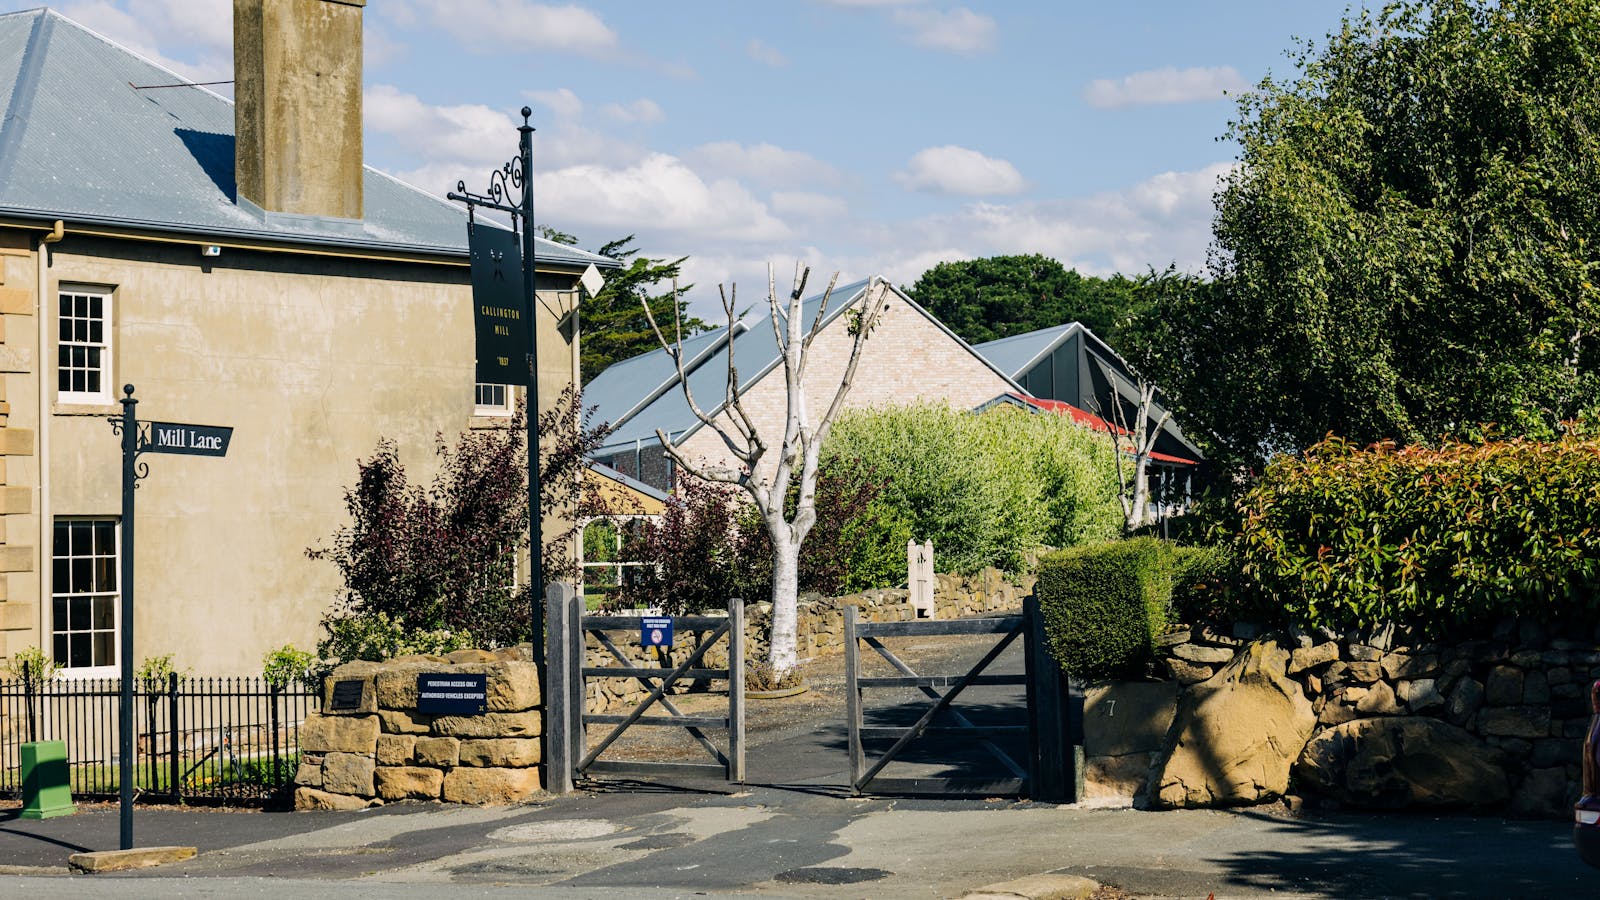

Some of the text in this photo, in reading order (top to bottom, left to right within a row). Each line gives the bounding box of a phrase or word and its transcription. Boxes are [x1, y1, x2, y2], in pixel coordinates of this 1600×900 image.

[481, 305, 520, 320] CALLINGTON
[494, 325, 509, 336] MILL
[158, 428, 222, 450] Mill Lane
[427, 680, 450, 688] PEDESTRIAN
[445, 692, 464, 700] VEHICLES
[1106, 700, 1116, 717] 7
